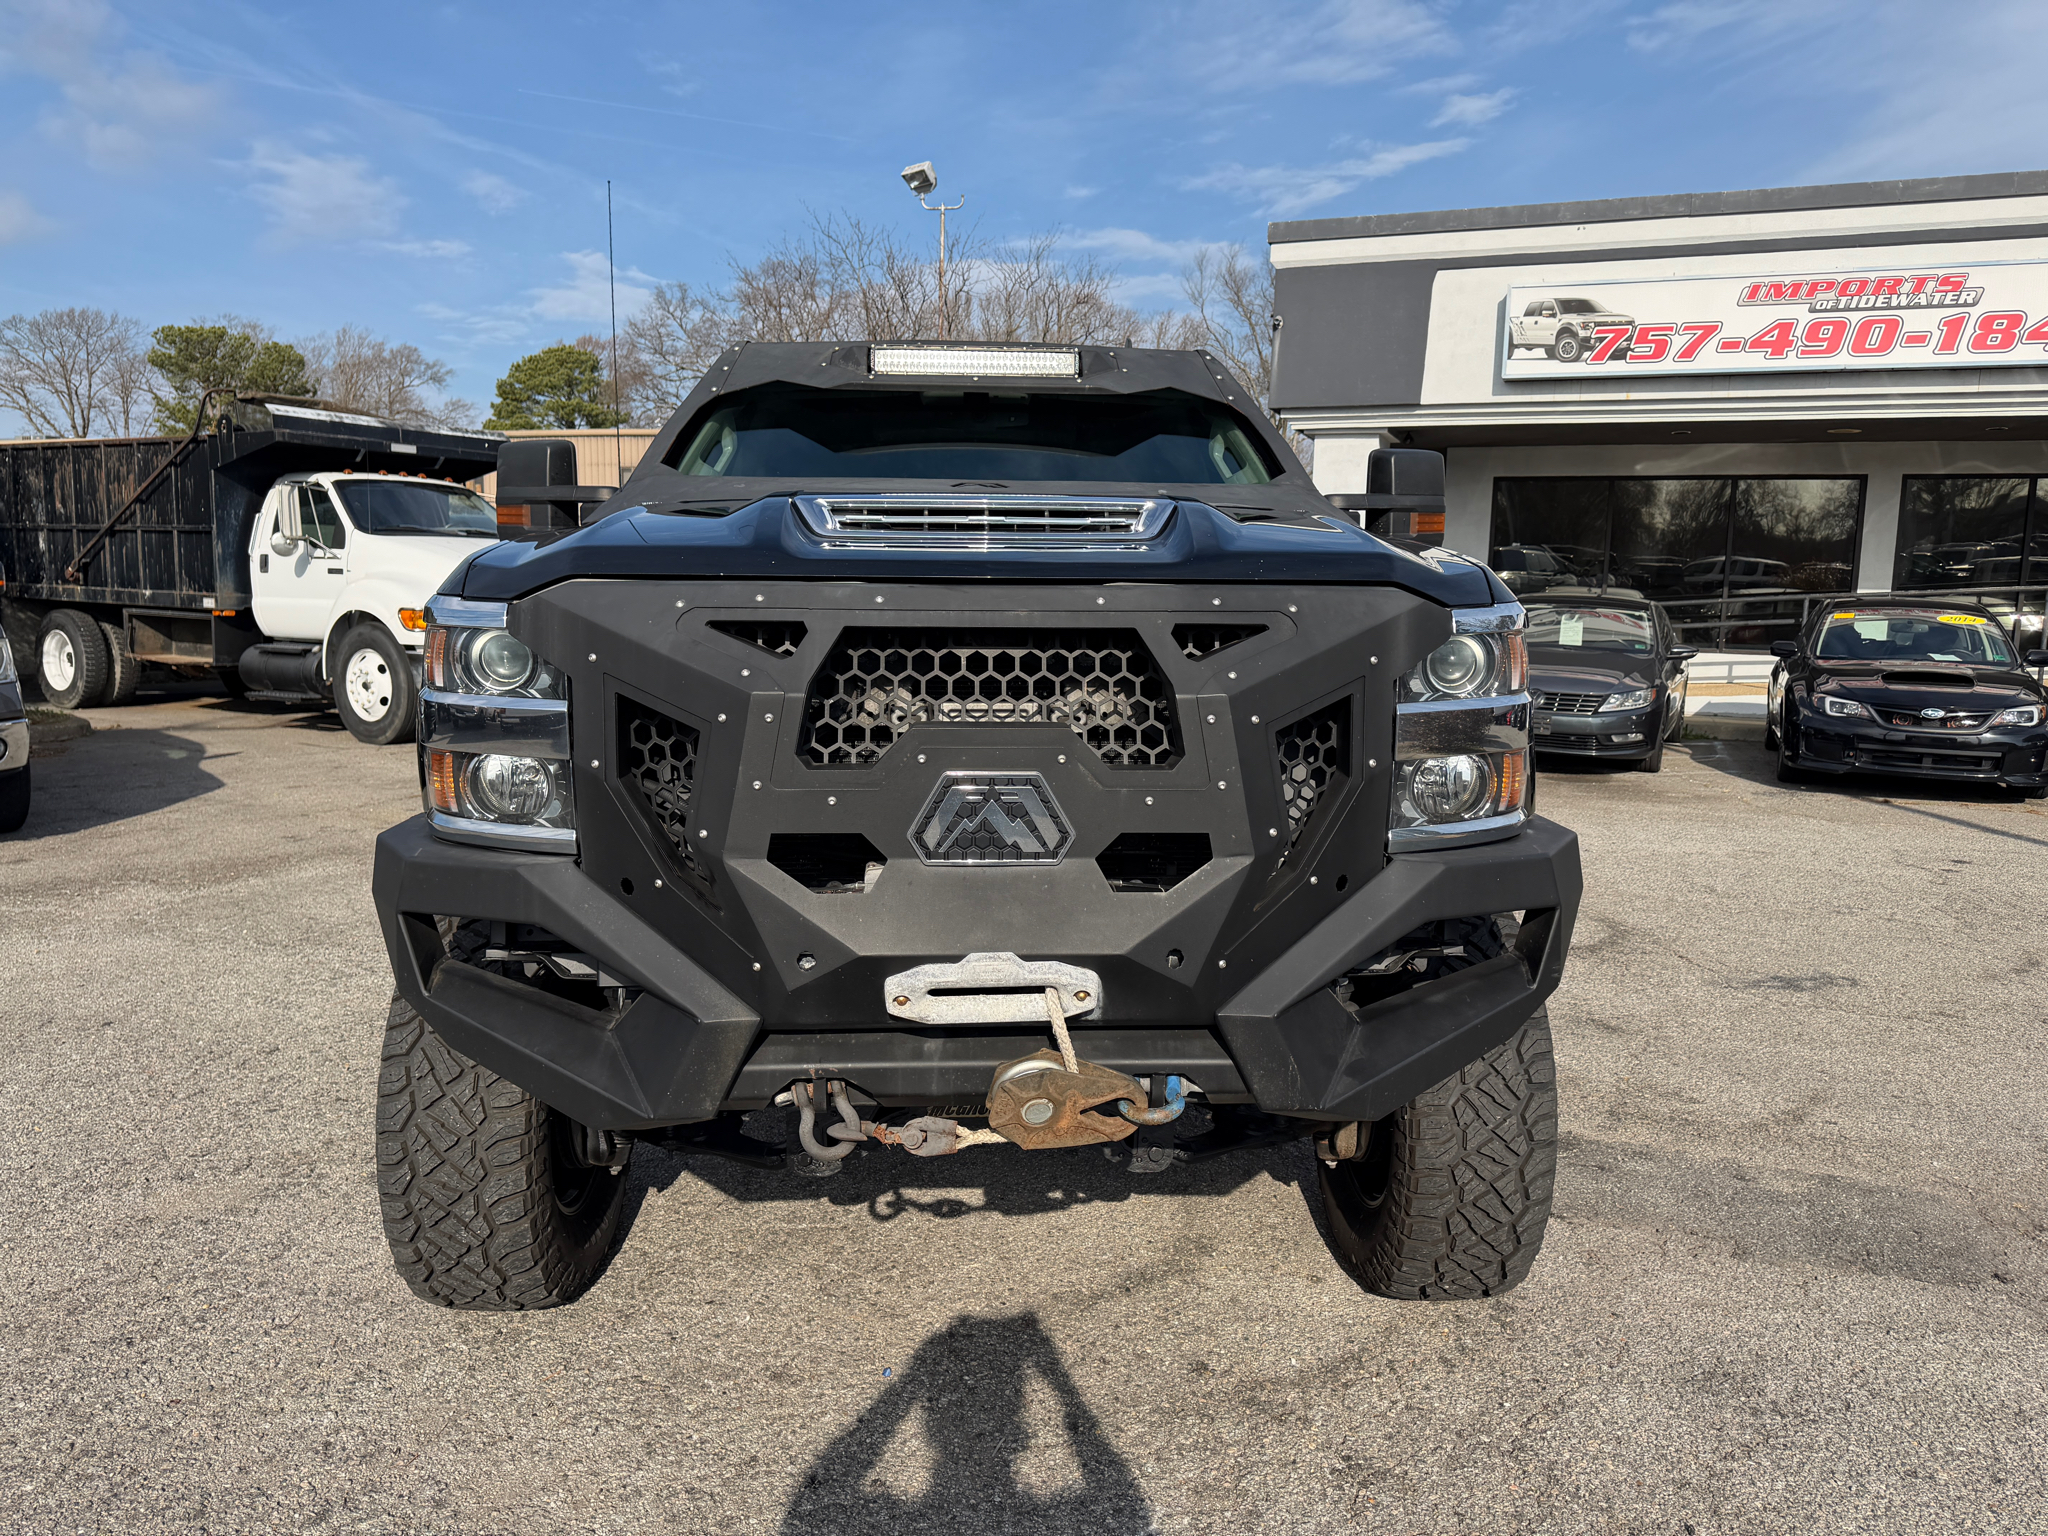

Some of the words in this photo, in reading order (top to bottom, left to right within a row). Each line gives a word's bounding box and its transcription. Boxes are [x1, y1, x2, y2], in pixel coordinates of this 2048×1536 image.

[1743, 272, 1969, 302] IMPORTS
[1815, 299, 1838, 310] OF
[1836, 290, 1978, 310] TIDEWATER
